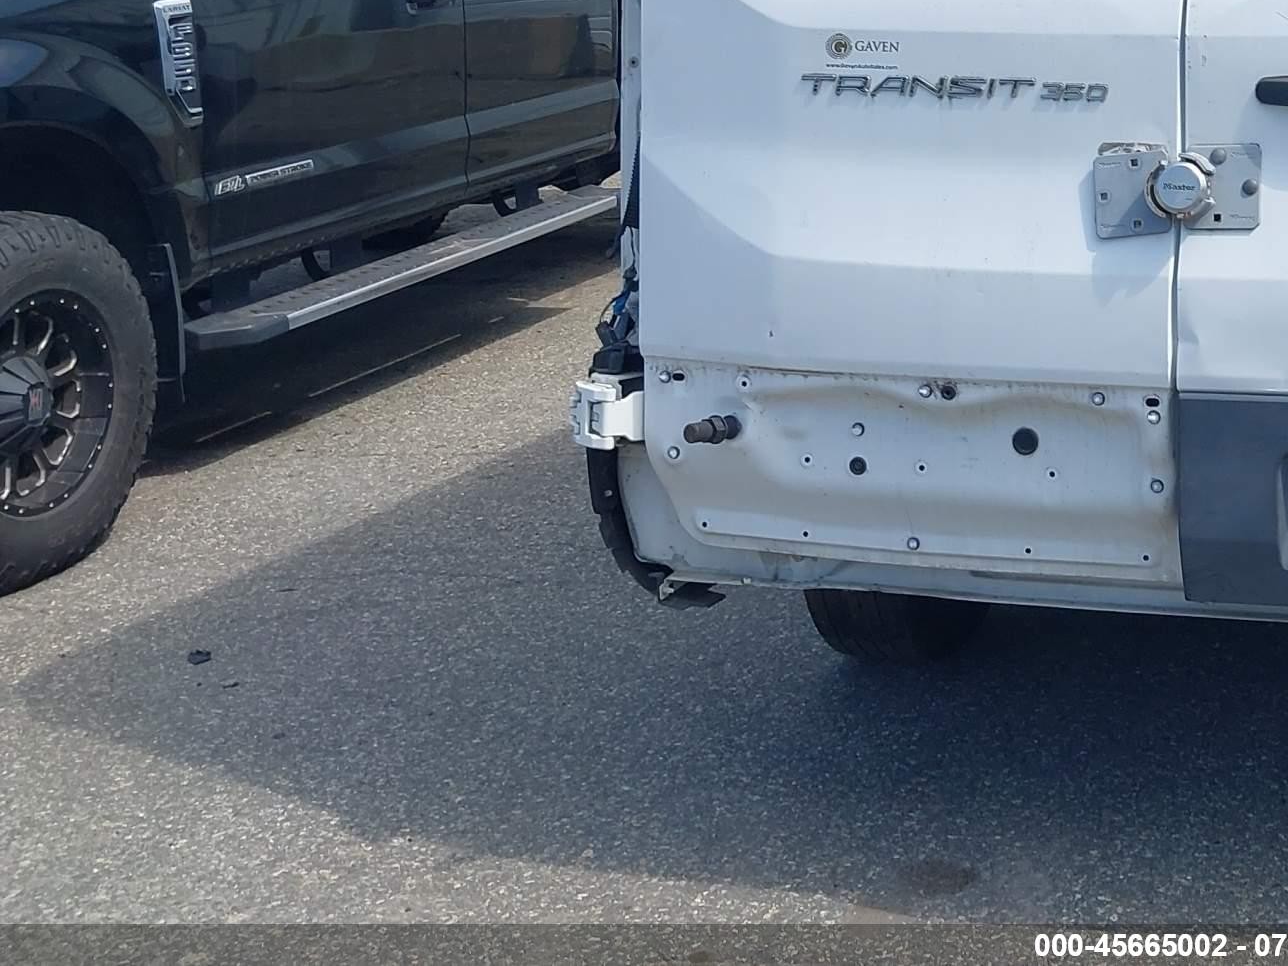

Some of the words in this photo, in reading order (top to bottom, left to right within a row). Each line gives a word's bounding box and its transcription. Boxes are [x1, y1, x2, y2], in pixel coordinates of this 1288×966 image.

[854, 40, 899, 53] GAVEN
[801, 73, 1037, 99] TRANSIT
[1041, 81, 1109, 102] 350
